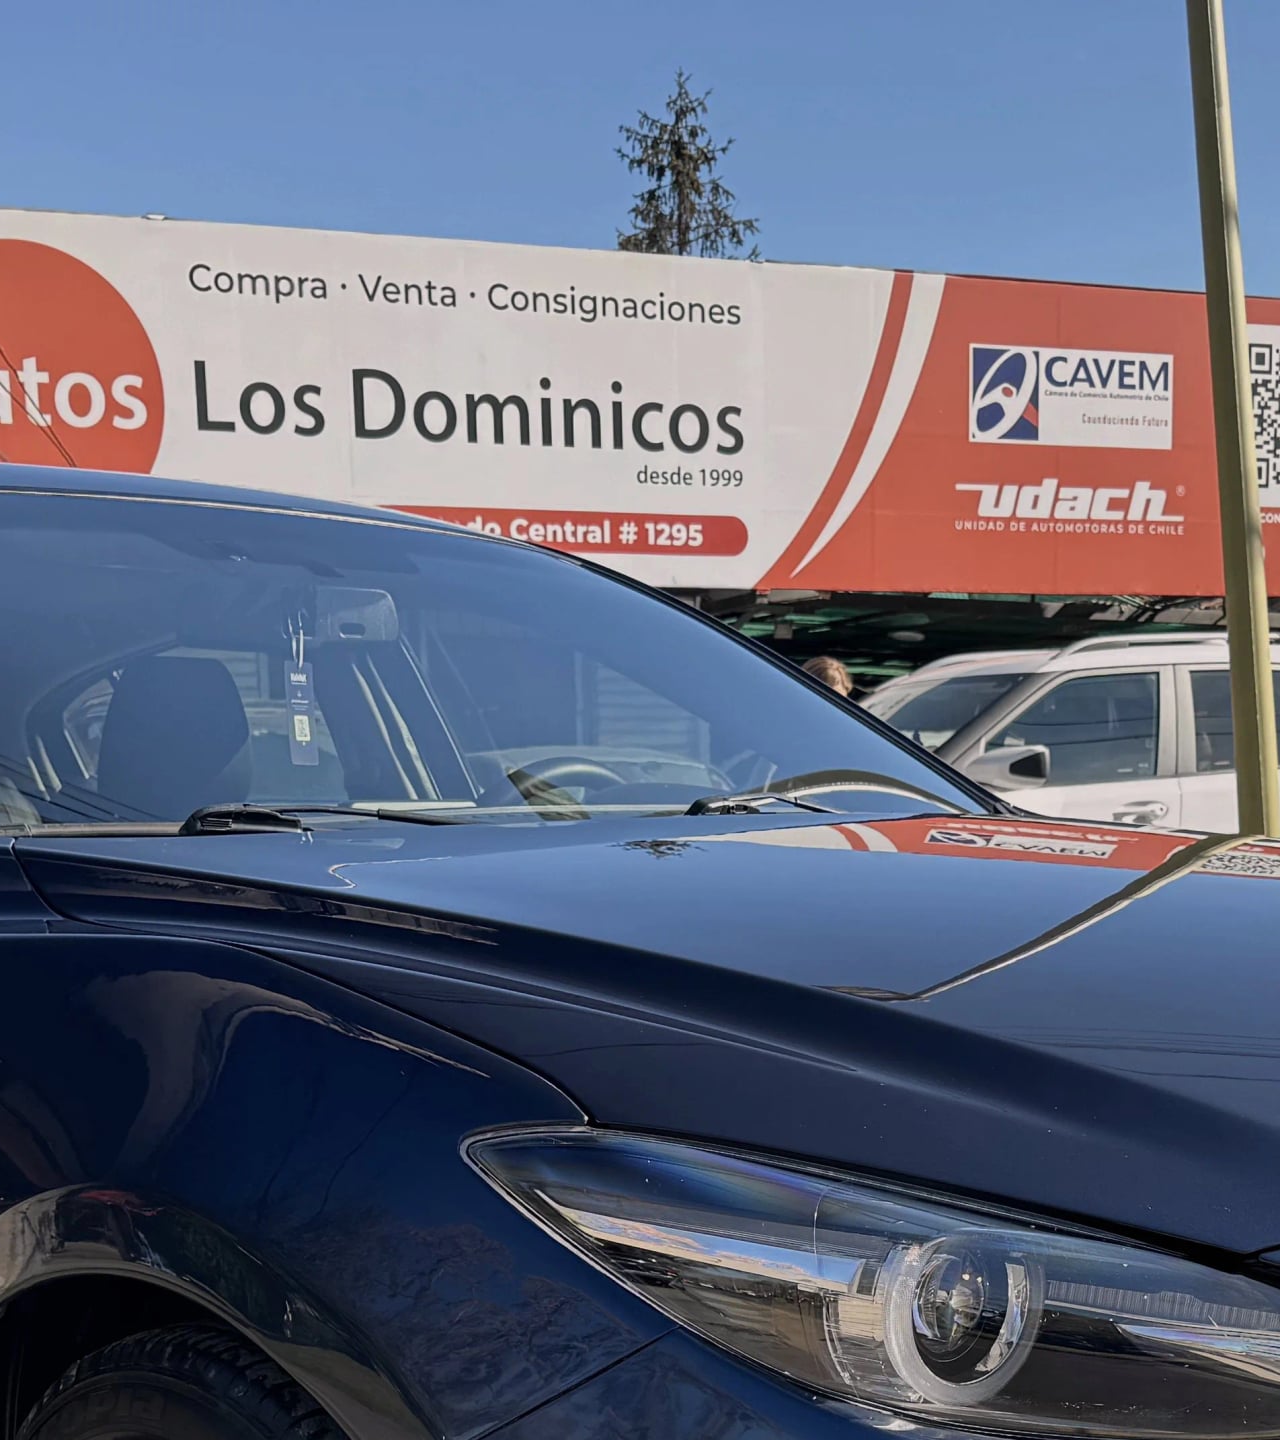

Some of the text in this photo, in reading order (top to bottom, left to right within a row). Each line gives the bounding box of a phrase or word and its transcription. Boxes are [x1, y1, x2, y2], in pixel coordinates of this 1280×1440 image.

[188, 263, 742, 325] Compra Venta Consignaciones
[1044, 355, 1169, 391] CAVEM
[193, 359, 325, 437] Los
[352, 368, 744, 455] Dominicos
[636, 465, 743, 488] desde 1999
[955, 478, 1185, 522] udach
[509, 518, 611, 544] Central
[618, 522, 638, 545] #
[644, 522, 704, 547] 1295
[955, 521, 1185, 535] UNIDAD DE AUTOMOTORAS DE CHILE
